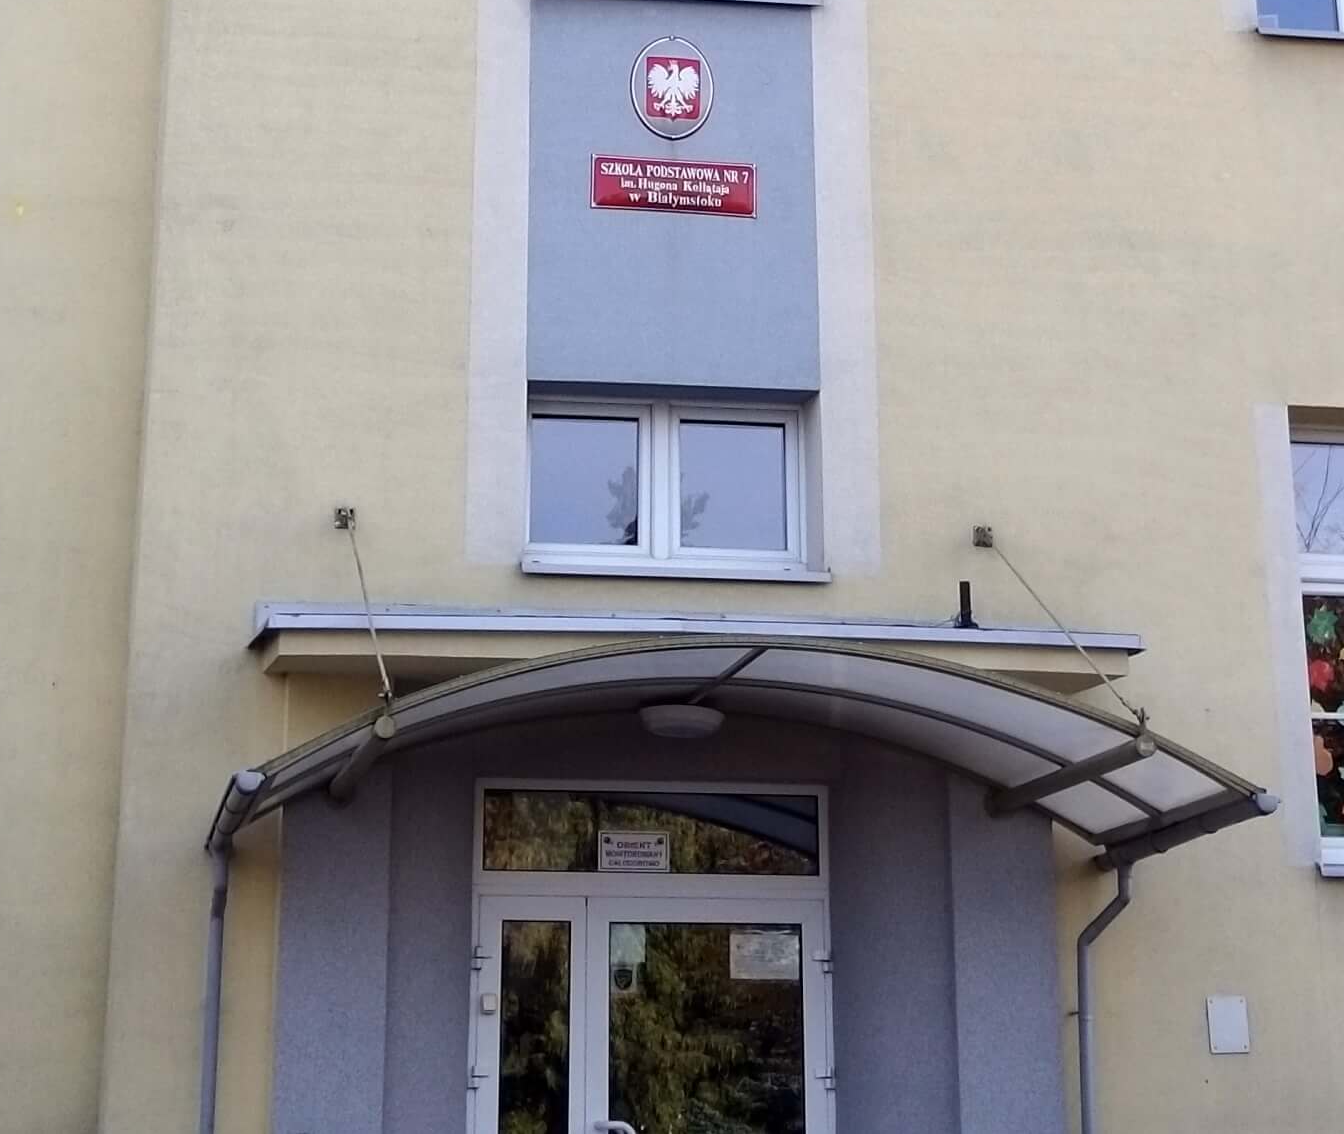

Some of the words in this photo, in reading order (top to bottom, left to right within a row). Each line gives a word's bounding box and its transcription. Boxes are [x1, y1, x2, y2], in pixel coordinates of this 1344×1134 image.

[646, 164, 721, 182] PODSTAWOWA
[723, 169, 739, 184] NR
[742, 171, 749, 184] 7
[638, 177, 678, 192] Hugona
